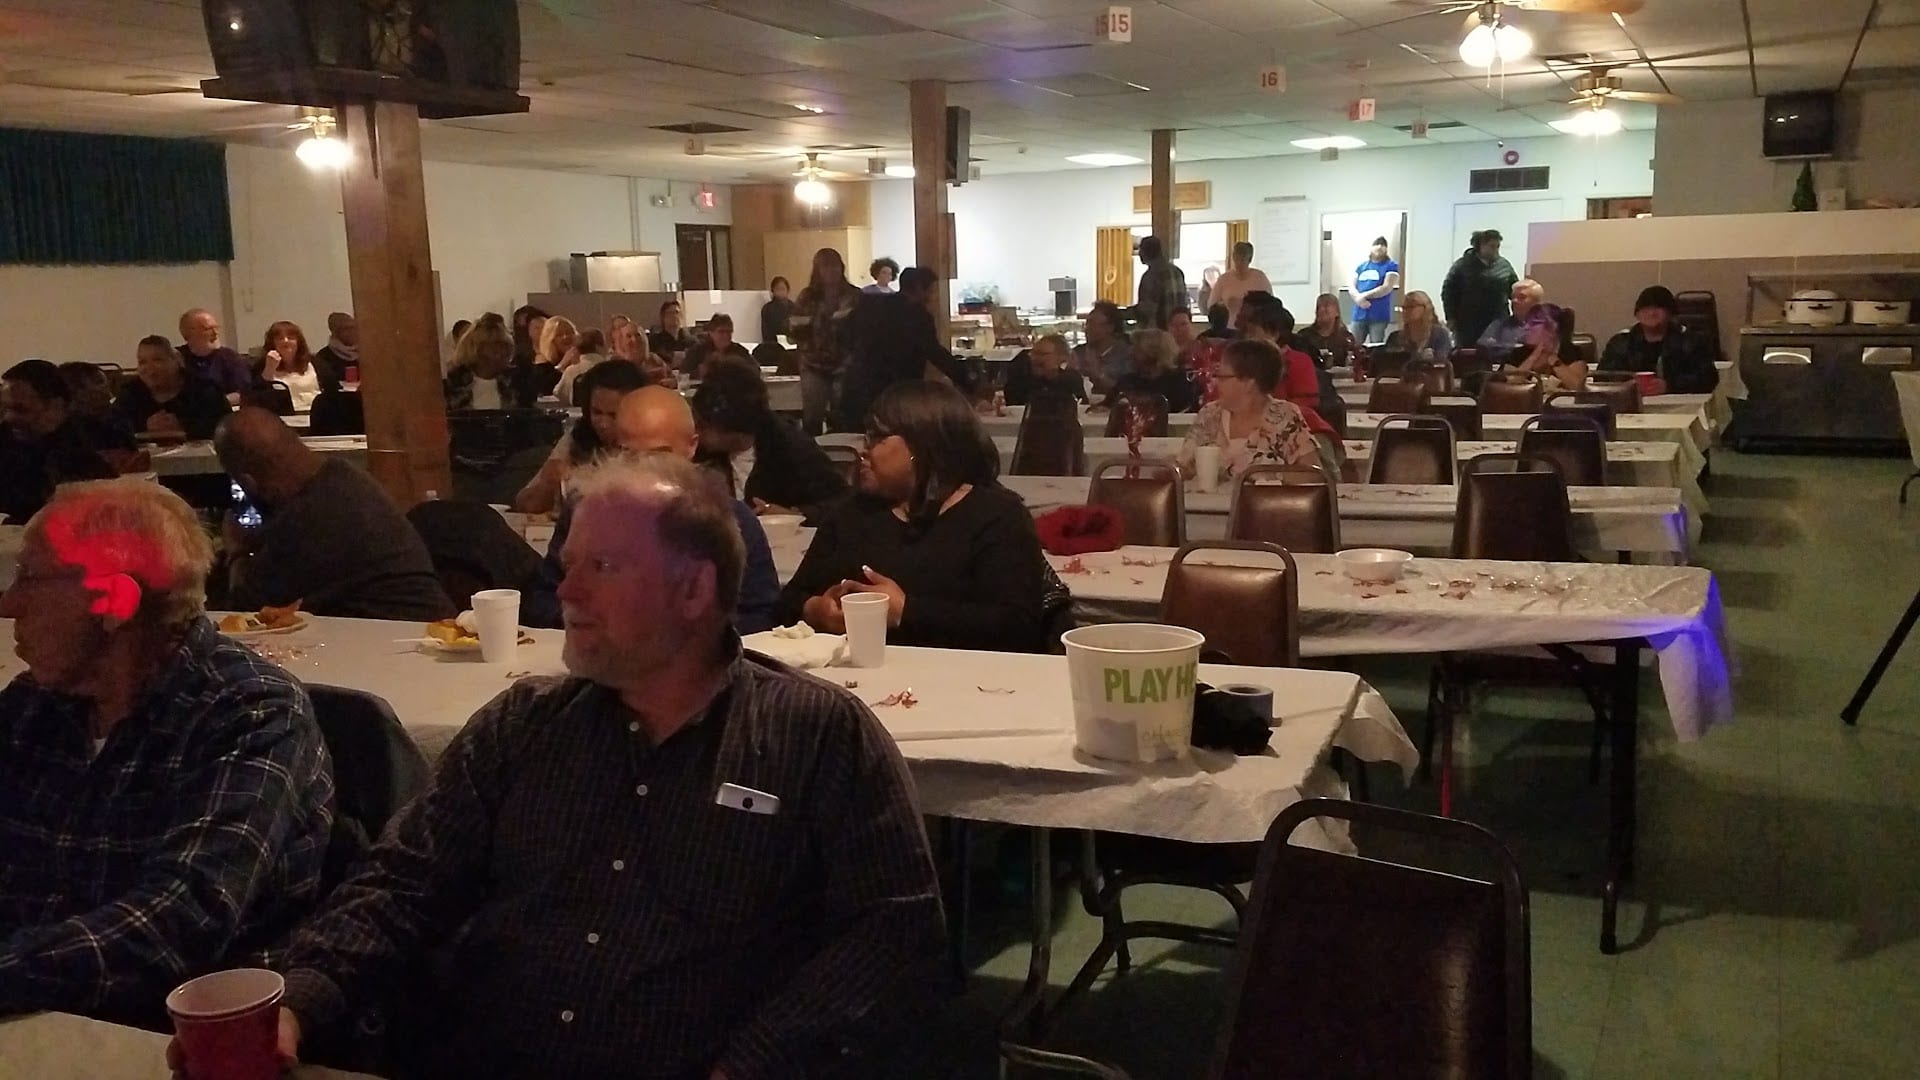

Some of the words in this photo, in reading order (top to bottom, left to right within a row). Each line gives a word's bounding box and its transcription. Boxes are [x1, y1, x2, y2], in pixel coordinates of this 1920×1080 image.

[1111, 13, 1129, 33] 15
[1261, 71, 1278, 88] 16
[1361, 102, 1373, 116] 17
[1103, 667, 1173, 704] PLAY
[1176, 662, 1197, 699] H
